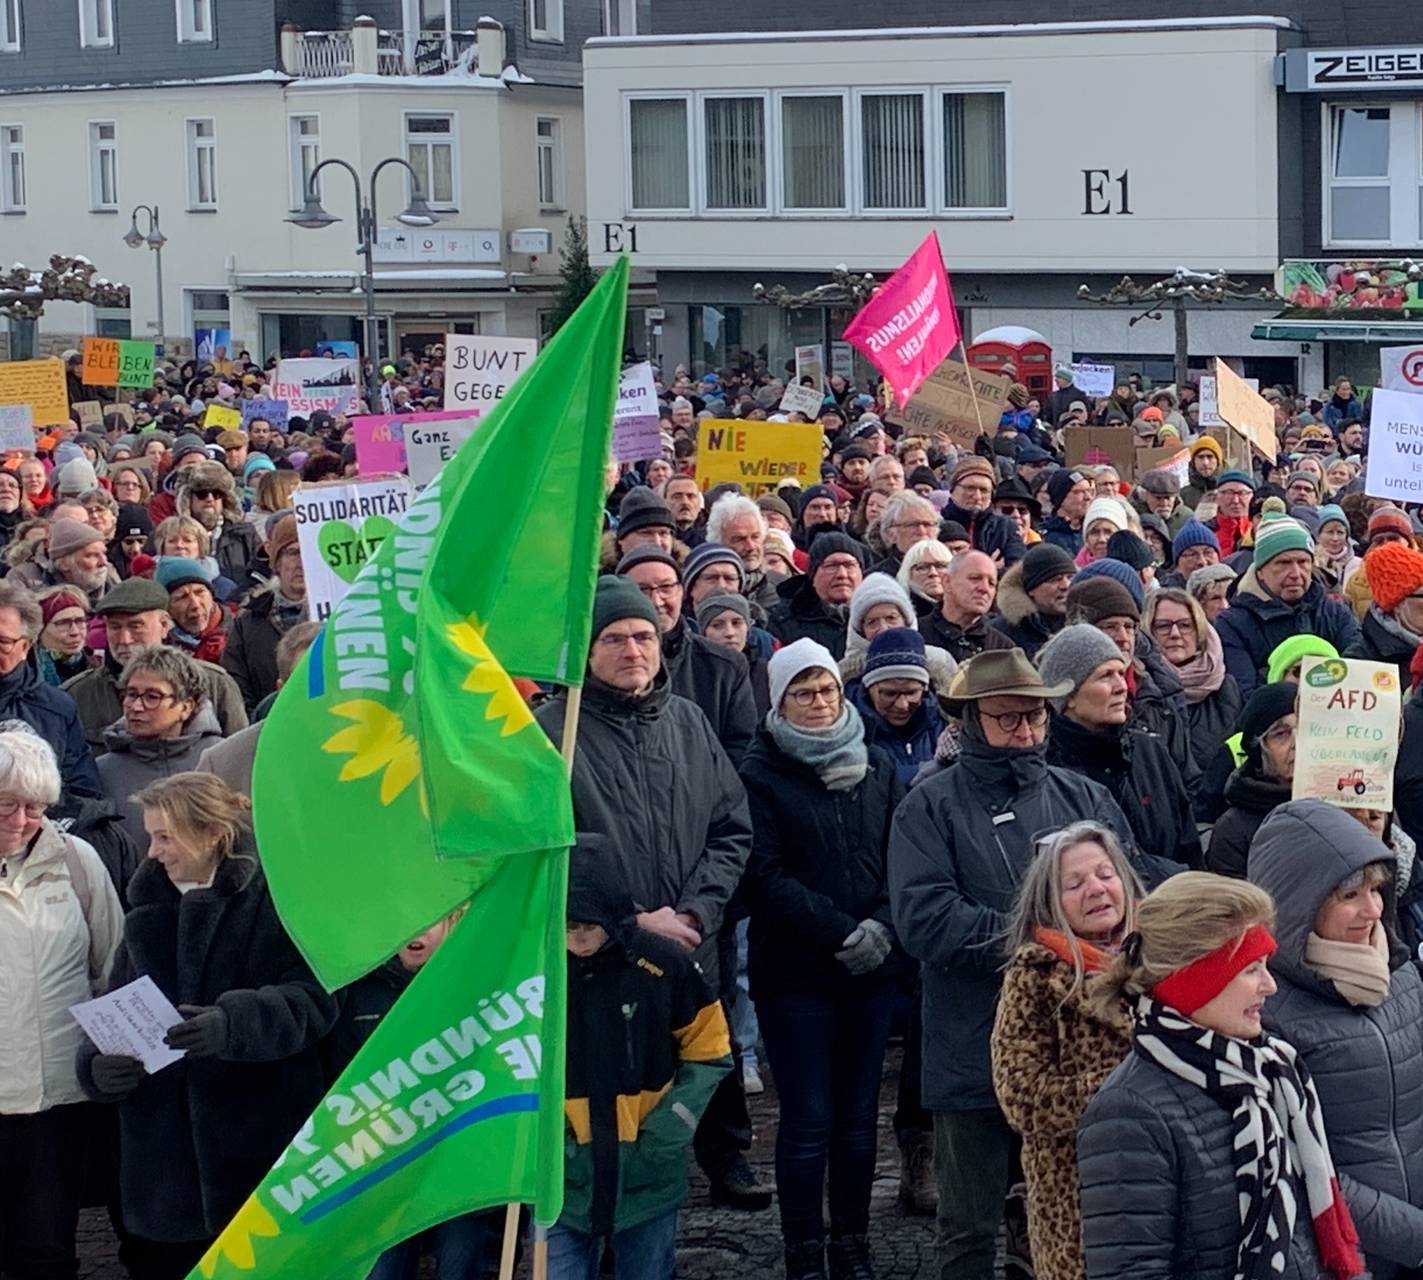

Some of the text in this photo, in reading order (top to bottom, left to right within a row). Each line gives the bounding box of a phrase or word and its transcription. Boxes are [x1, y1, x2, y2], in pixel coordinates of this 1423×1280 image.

[1082, 169, 1133, 215] E1
[603, 223, 640, 253] E1
[92, 340, 120, 353] WIR
[453, 346, 528, 372] BUNT
[454, 381, 504, 400] GEGE
[619, 386, 647, 399] ken
[412, 429, 451, 445] Ganz
[296, 489, 408, 524] SOLIDARITÄT
[327, 537, 386, 567] STAT
[1327, 687, 1378, 711] AFD
[1309, 722, 1384, 741] KEIN FELD
